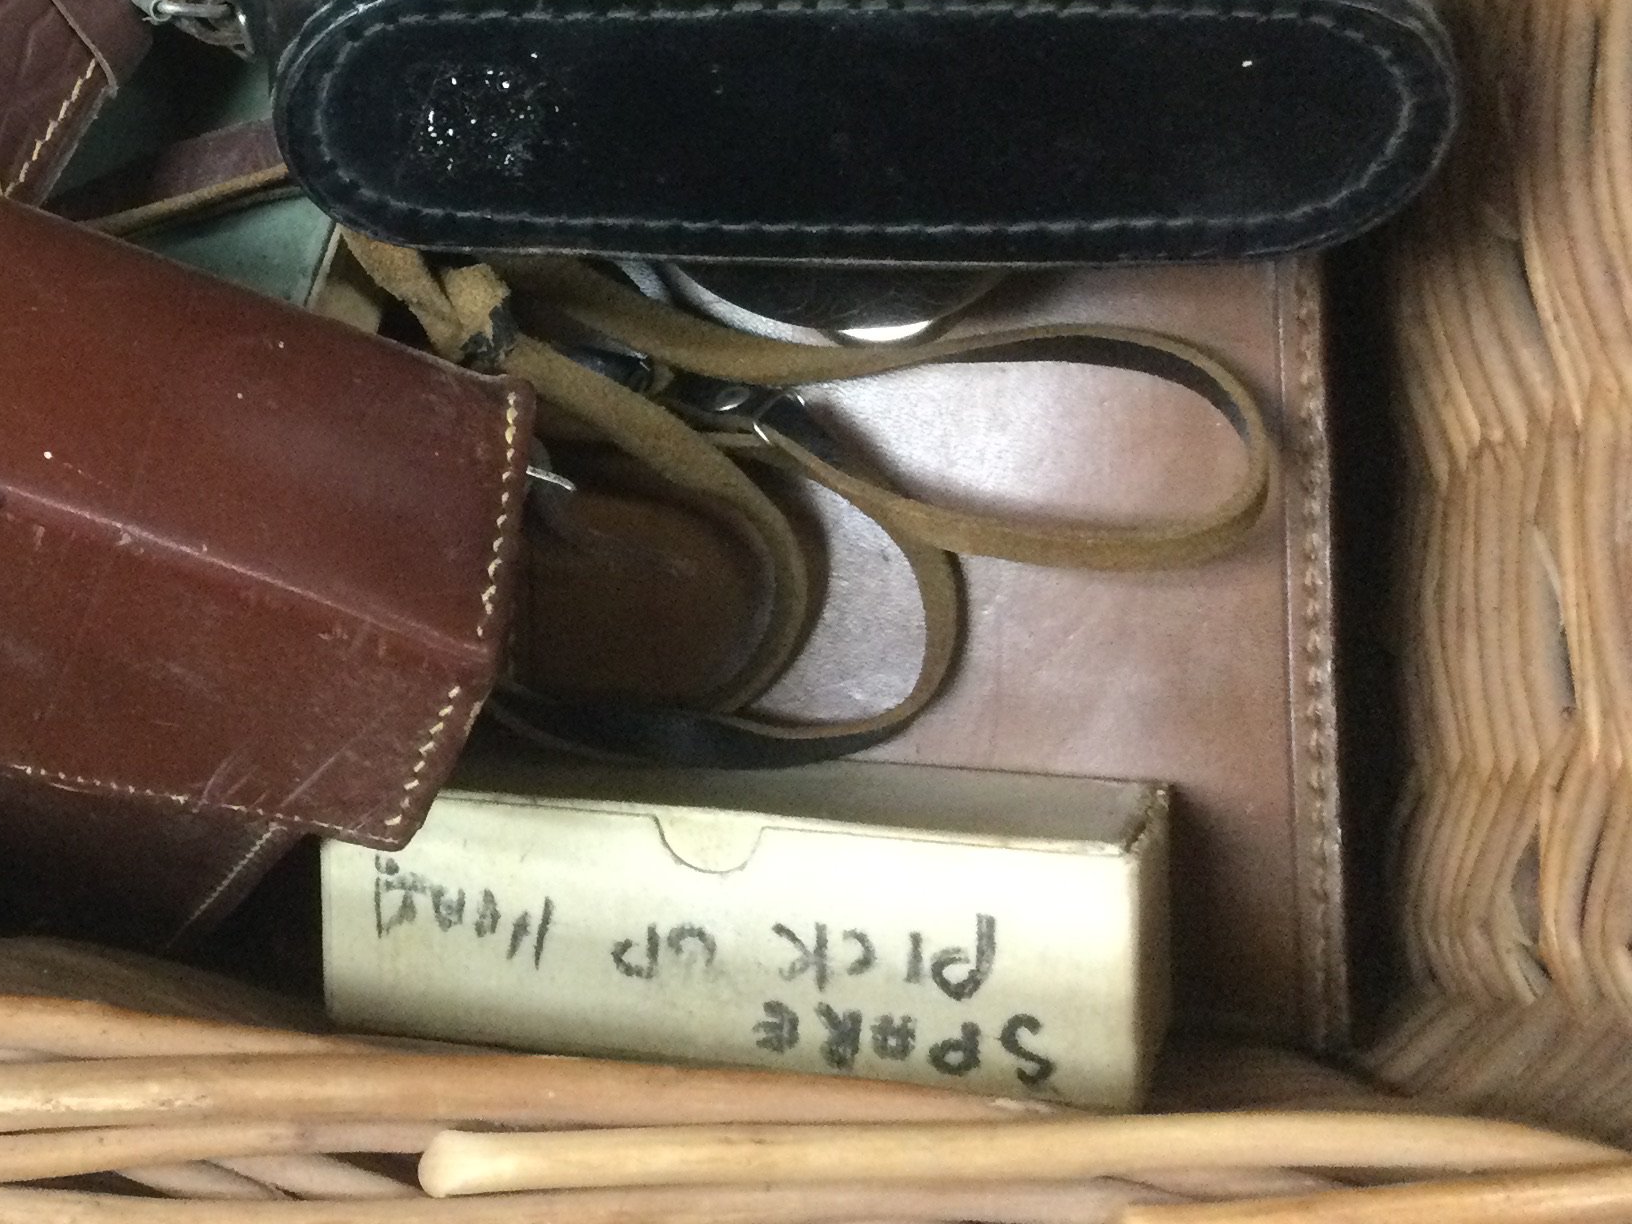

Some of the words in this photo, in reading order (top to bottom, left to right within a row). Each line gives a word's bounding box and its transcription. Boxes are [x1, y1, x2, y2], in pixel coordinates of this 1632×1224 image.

[610, 920, 717, 979] UP
[771, 912, 997, 1002] PICK
[752, 1000, 1057, 1087] SPARE
